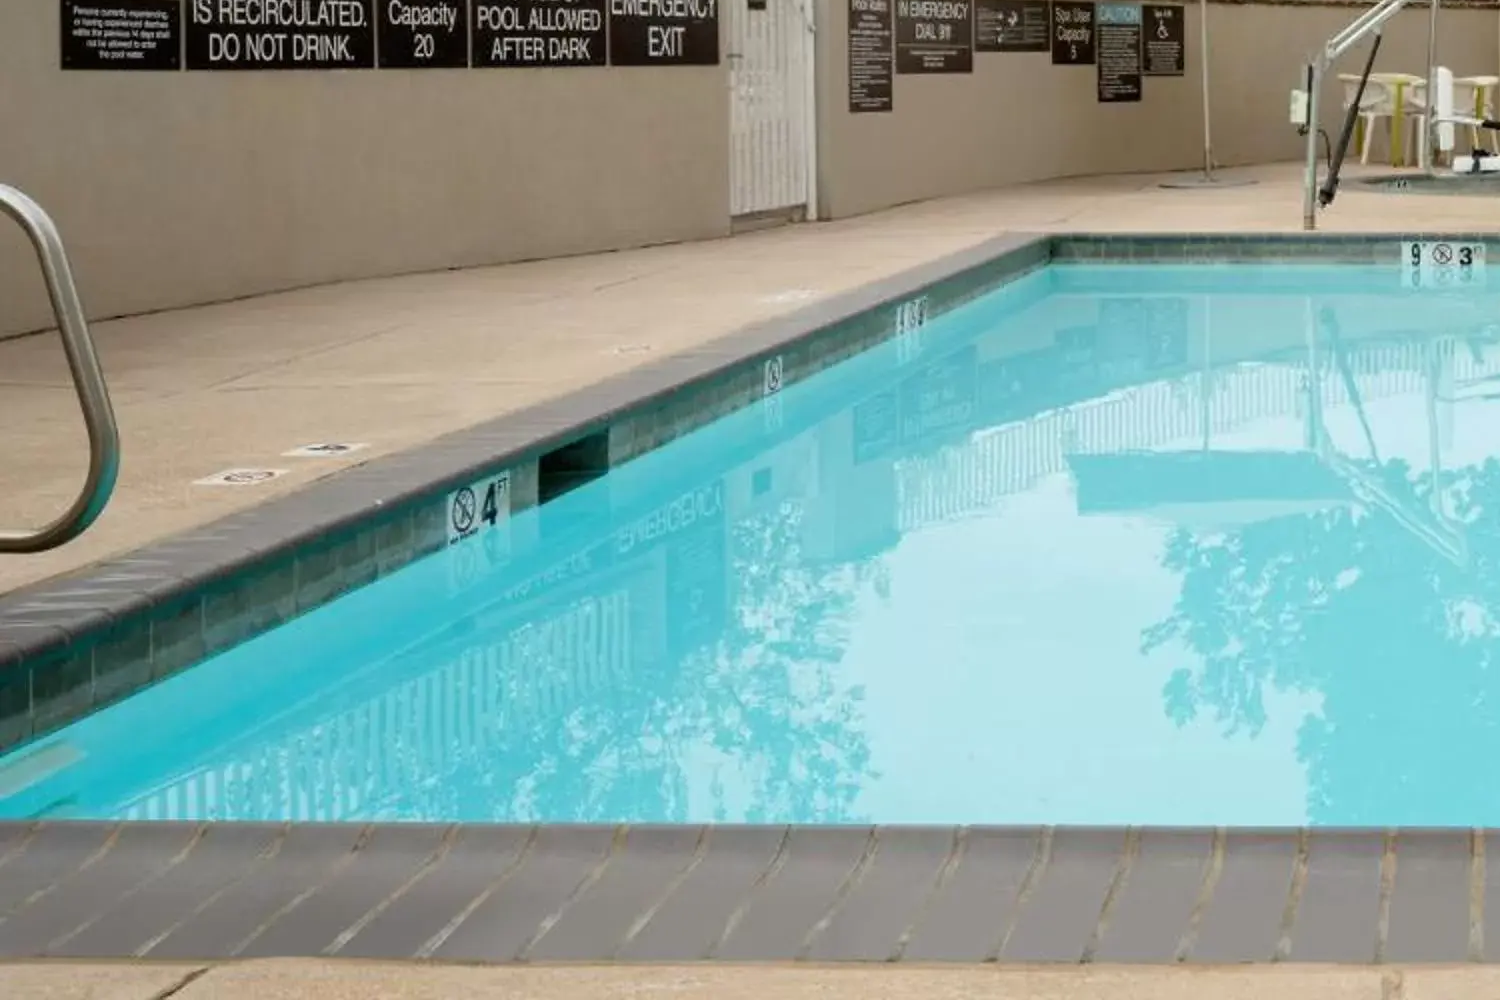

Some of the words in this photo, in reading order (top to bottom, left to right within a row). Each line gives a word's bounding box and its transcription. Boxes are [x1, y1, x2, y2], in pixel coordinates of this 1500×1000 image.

[388, 0, 456, 32] Capacity
[478, 7, 523, 30] POOL
[528, 9, 601, 31] ALLOWED
[898, 0, 908, 17] IN
[910, 1, 969, 19] EMERGENCY
[1055, 7, 1070, 24] Spa
[1072, 8, 1091, 23] User
[1100, 5, 1138, 21] CAUTION
[648, 27, 686, 56] EXIT
[915, 23, 936, 40] DIAL
[938, 23, 951, 40] 911
[1056, 25, 1091, 45] Capacity
[209, 34, 239, 61] DO
[246, 34, 286, 61] NOT
[293, 35, 354, 61] DRINK.
[414, 34, 434, 57] 20
[491, 37, 544, 60] AFTER
[550, 38, 591, 59] DARK
[1459, 246, 1473, 265] 3
[482, 481, 498, 526] 4
